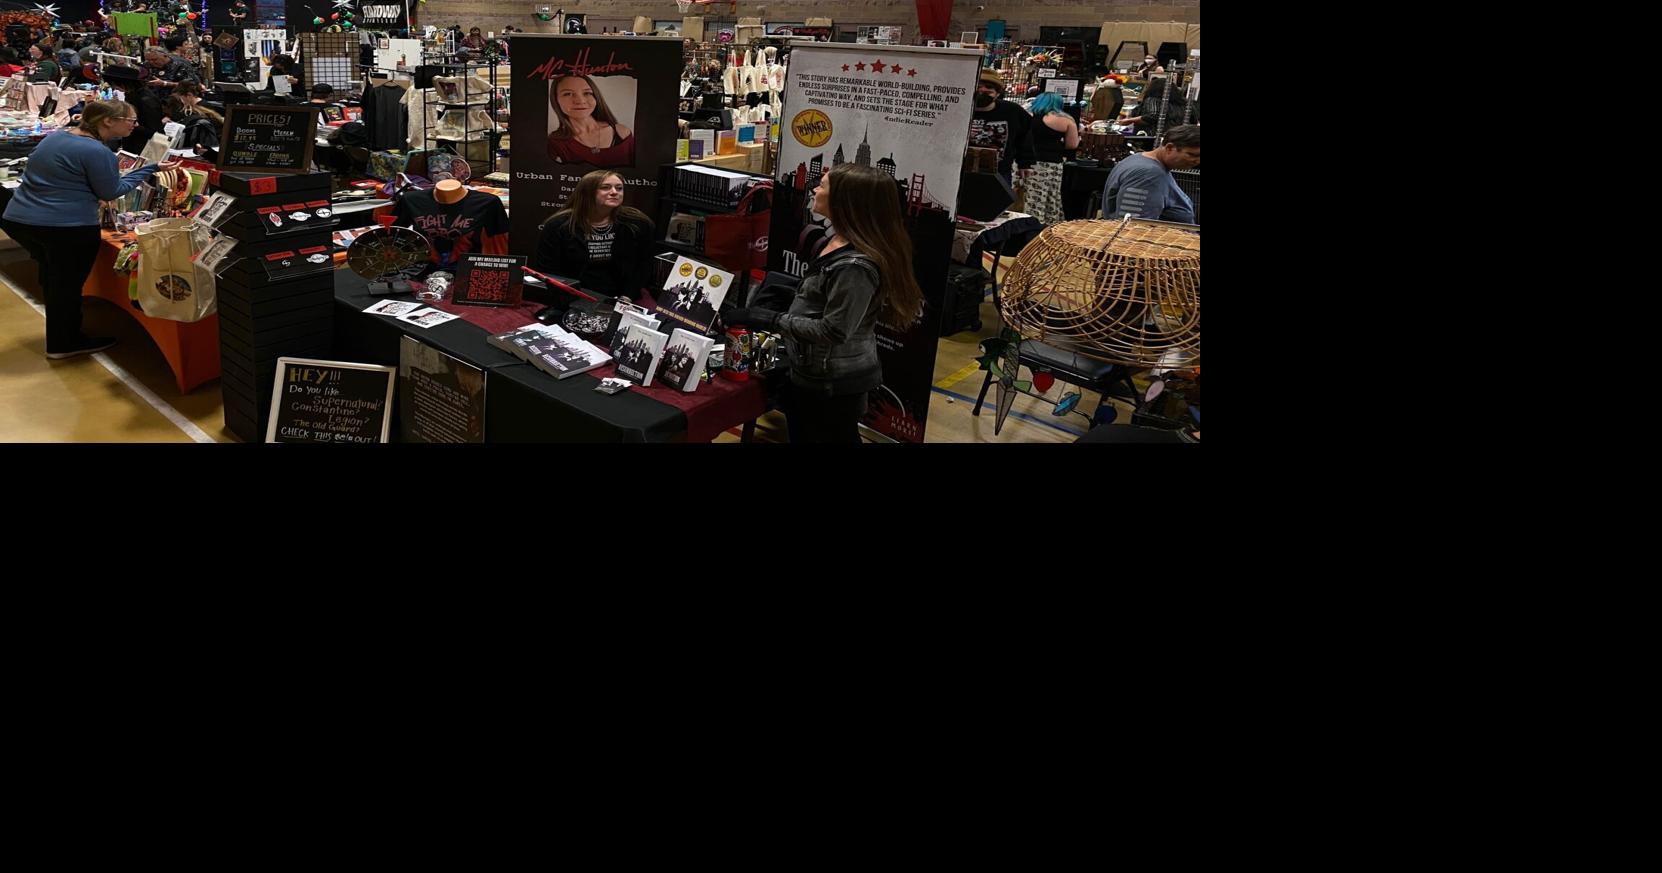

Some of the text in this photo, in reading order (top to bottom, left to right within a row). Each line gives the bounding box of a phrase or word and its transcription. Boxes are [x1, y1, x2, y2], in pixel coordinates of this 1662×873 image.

[798, 81, 821, 90] ENDLESS
[821, 84, 850, 93] SURPRISES
[863, 88, 901, 99] FAST-PACED,
[901, 91, 944, 103] COMPELLING,
[945, 96, 960, 104] AND
[840, 77, 877, 87] REMARKABLE
[878, 80, 932, 93] WORLD-BUILDING,
[933, 85, 967, 95] PROVIDES
[805, 89, 838, 99] CAPTIVATING
[853, 94, 866, 102] AND
[866, 96, 881, 104] SETS
[894, 98, 914, 108] STAGE
[915, 101, 928, 109] FOR
[929, 102, 948, 112] WHAT
[808, 97, 834, 107] PROMISES
[855, 103, 893, 113] FASCINATING
[894, 107, 912, 116] SCI-FI
[248, 113, 292, 125] PRICES!
[515, 171, 657, 187] Urban Fan Autho
[782, 249, 809, 279] The
[289, 367, 342, 386] HEY!!!
[289, 384, 303, 393] Do
[306, 386, 321, 396] you
[281, 426, 310, 439] CHECK
[314, 431, 333, 441] THIS
[294, 419, 310, 427] The
[312, 421, 327, 430] Old
